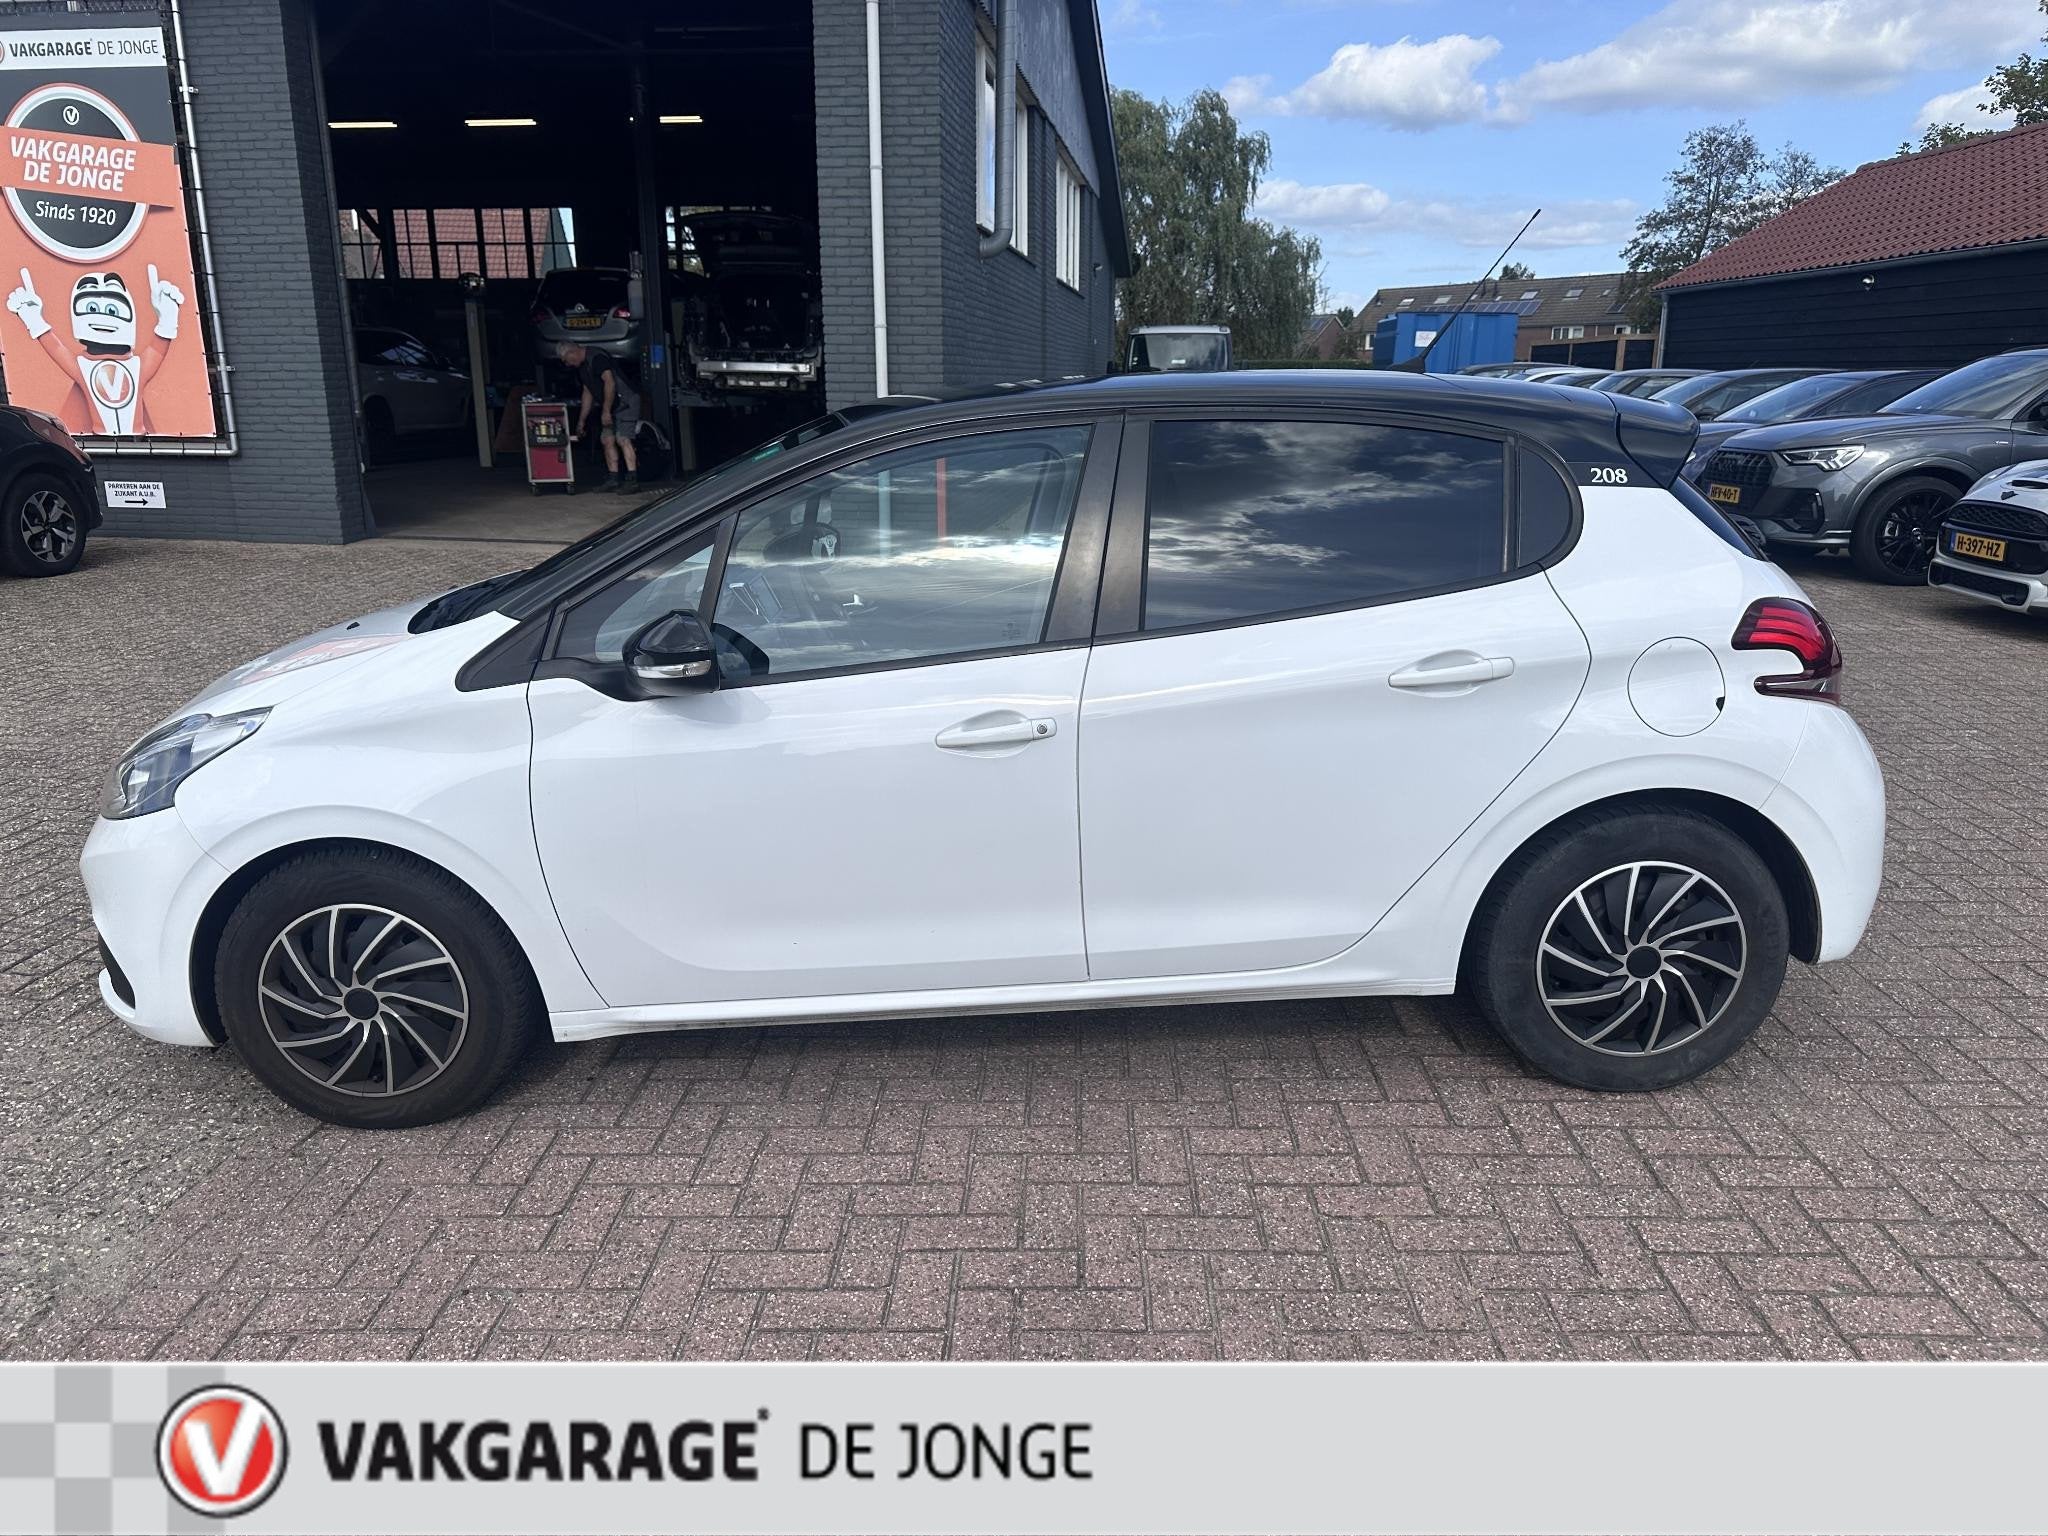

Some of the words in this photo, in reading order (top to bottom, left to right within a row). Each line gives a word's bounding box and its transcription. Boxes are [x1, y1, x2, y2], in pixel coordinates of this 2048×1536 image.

[9, 41, 92, 57] VAKGARAGE
[97, 41, 115, 55] DE
[118, 40, 159, 55] JONGE
[10, 136, 137, 171] VAKGARAGE
[23, 160, 51, 183] DE
[56, 165, 125, 192] JONGE
[35, 200, 75, 221] Sinds
[80, 206, 116, 226] 1920
[107, 482, 138, 490] PARKEREN
[1590, 467, 1628, 484] 208
[1956, 535, 2002, 558] H-397-HZ
